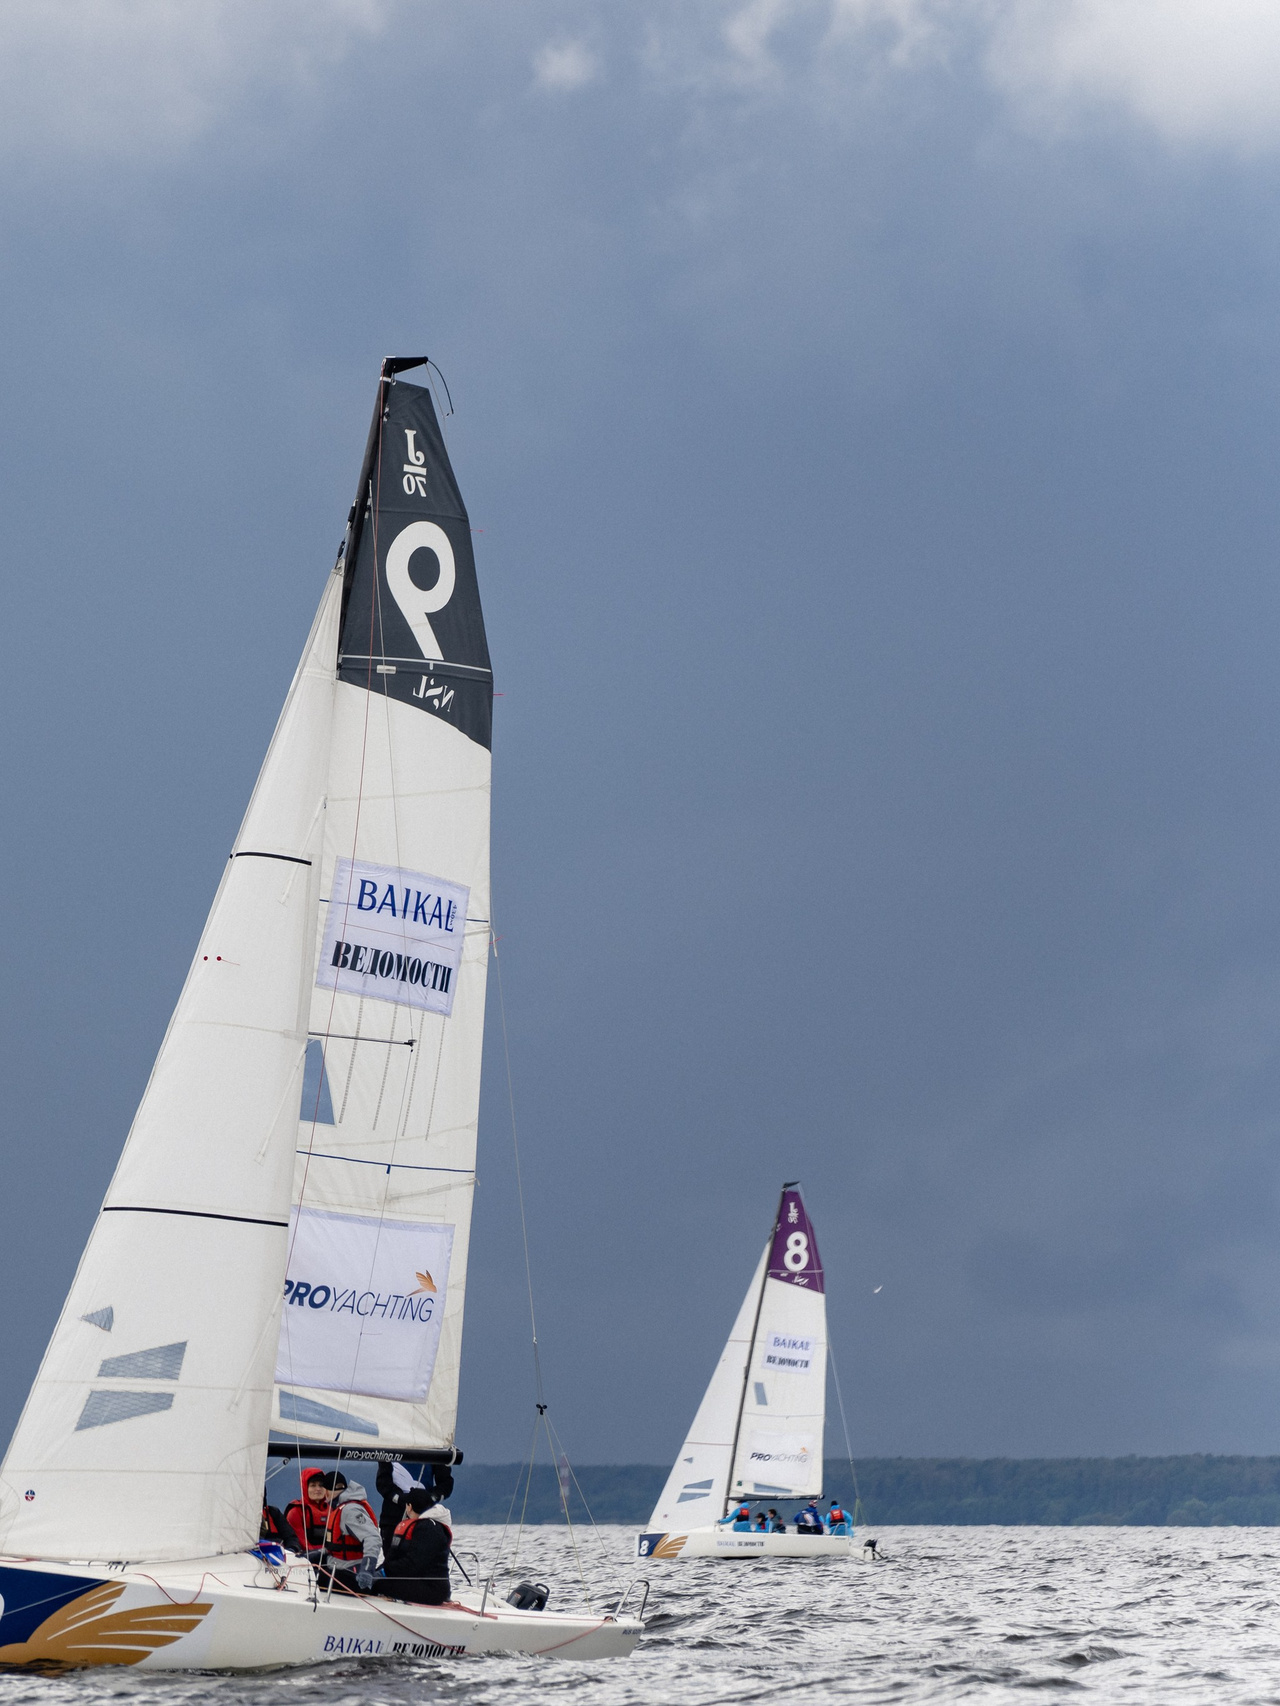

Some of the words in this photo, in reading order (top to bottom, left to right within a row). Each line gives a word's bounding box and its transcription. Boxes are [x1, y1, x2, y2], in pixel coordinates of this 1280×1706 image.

[357, 878, 454, 932] BAIKAL
[330, 940, 453, 993] ВЕДОМОСТИ
[784, 1231, 809, 1272] 8
[773, 1336, 810, 1351] BAIKAL
[344, 1450, 403, 1462] pro-yachting.ru
[639, 1540, 649, 1555] 8
